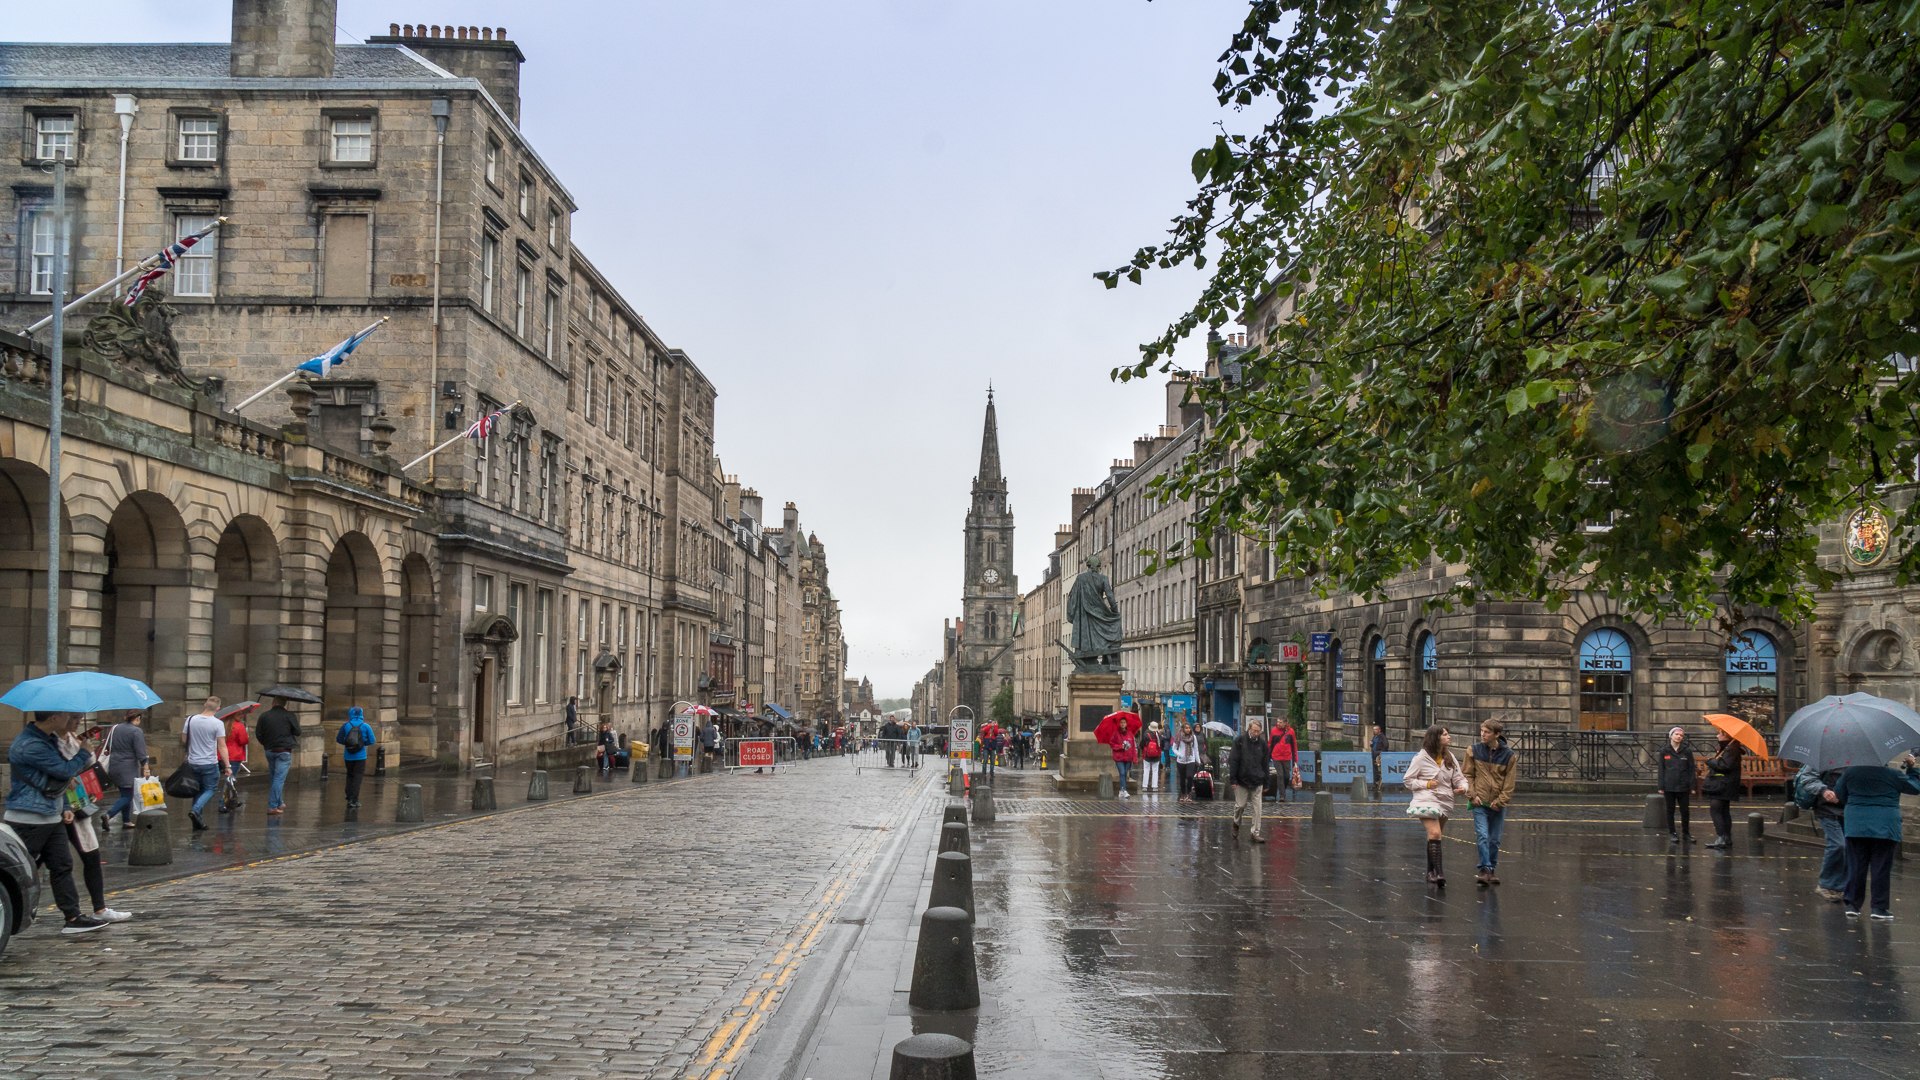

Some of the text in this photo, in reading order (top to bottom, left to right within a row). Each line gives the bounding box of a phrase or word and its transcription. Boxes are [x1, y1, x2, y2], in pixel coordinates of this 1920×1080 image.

[1584, 660, 1623, 668] NERO
[1730, 661, 1768, 670] NERO
[1328, 765, 1367, 773] NERO
